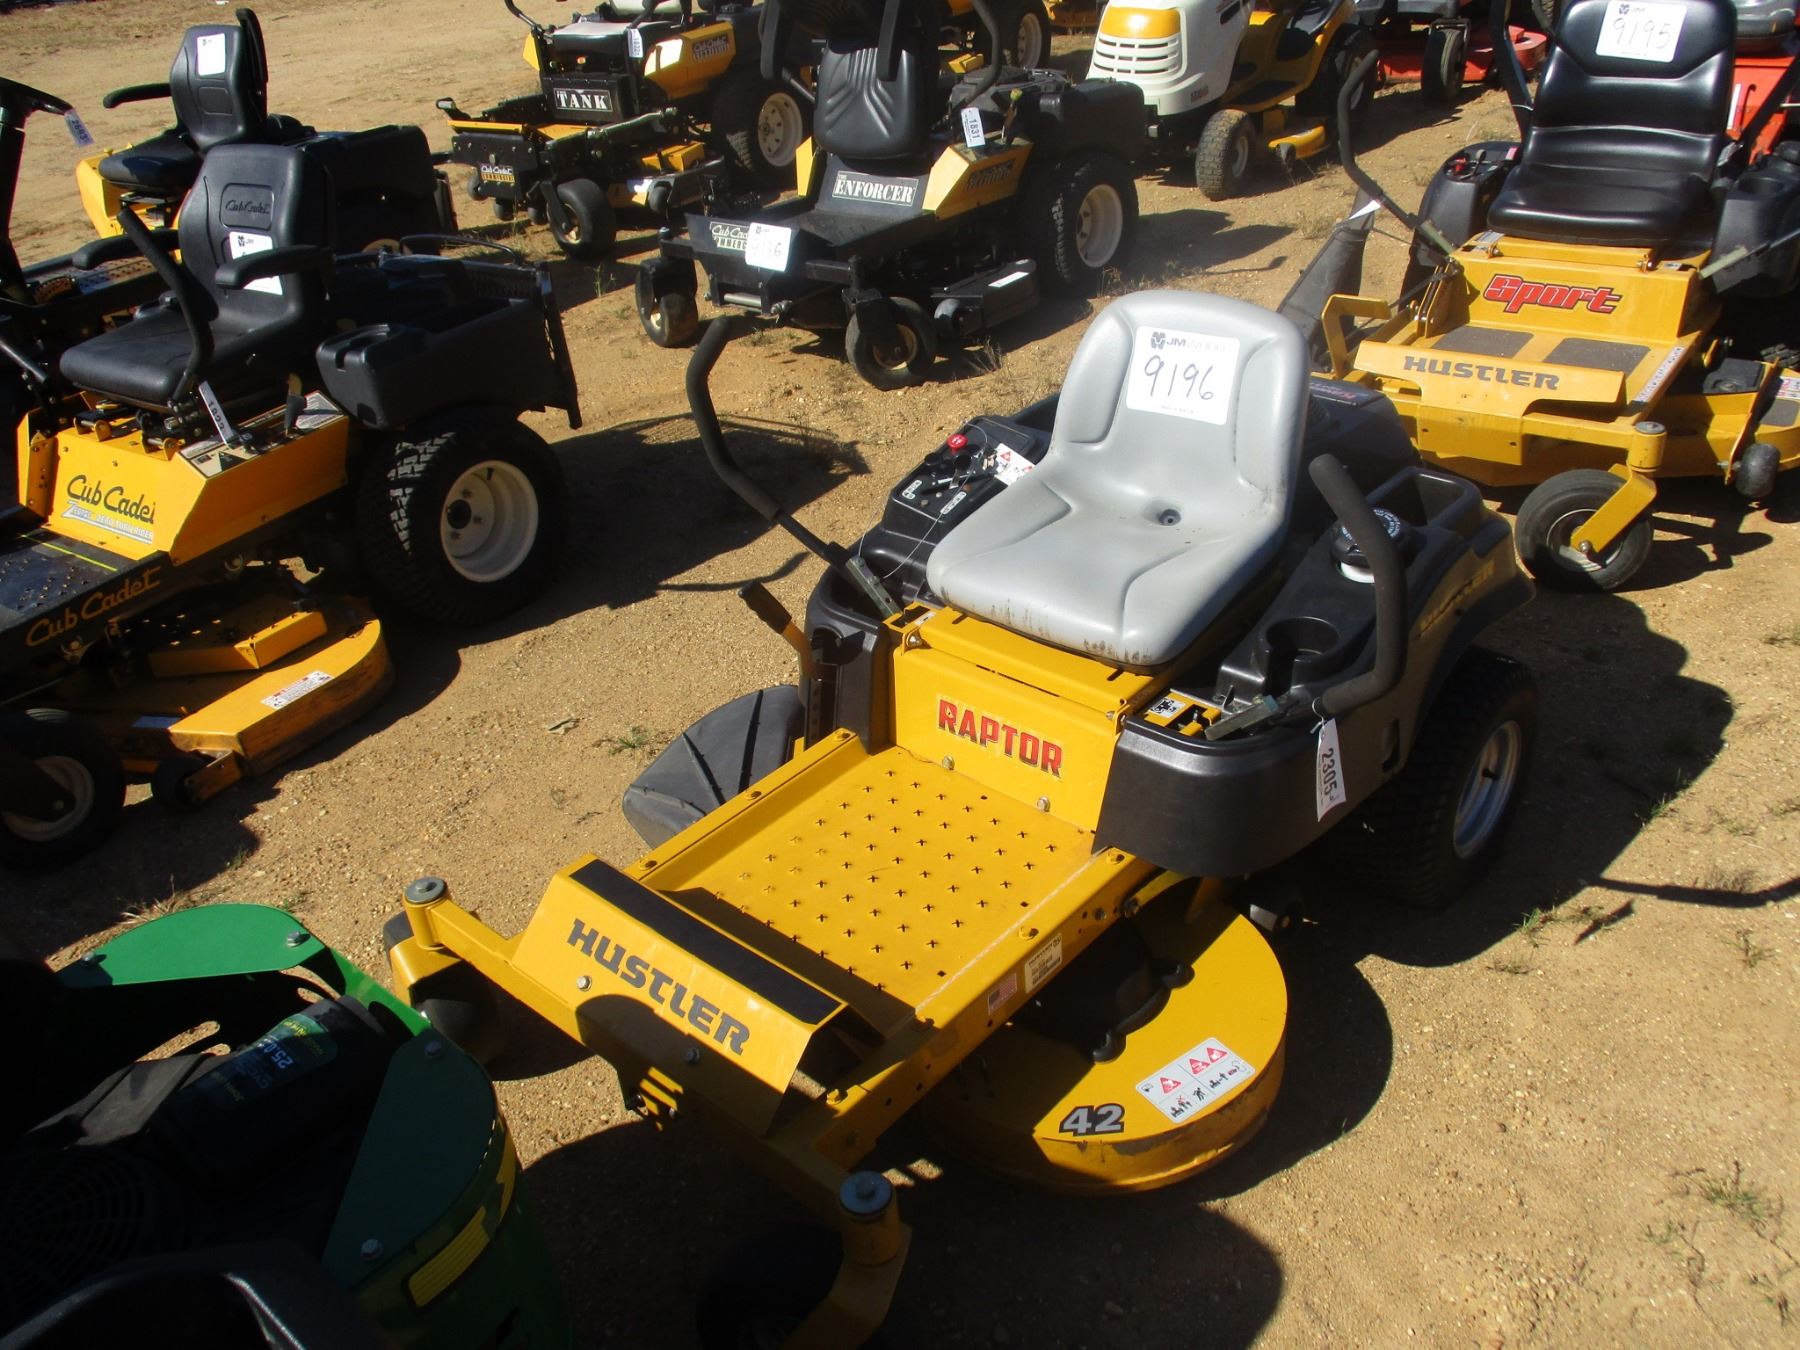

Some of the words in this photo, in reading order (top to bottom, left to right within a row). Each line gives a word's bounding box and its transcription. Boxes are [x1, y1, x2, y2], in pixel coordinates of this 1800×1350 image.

[1612, 17, 1671, 50] 9195
[556, 92, 608, 110] TANK
[968, 118, 981, 139] 1831
[833, 179, 914, 203] ENFORCER
[712, 224, 731, 237] Cub
[1482, 273, 1623, 314] Sport
[1144, 354, 1214, 401] 9196
[1403, 355, 1560, 390] HUSTLER
[66, 474, 102, 506] Cub
[25, 606, 79, 647] Cub
[80, 566, 161, 620] Cadet
[938, 698, 1063, 780] RAPTOR
[1321, 747, 1338, 796] 2305
[567, 918, 751, 1057] HUSTLER
[1058, 1102, 1126, 1137] 42
